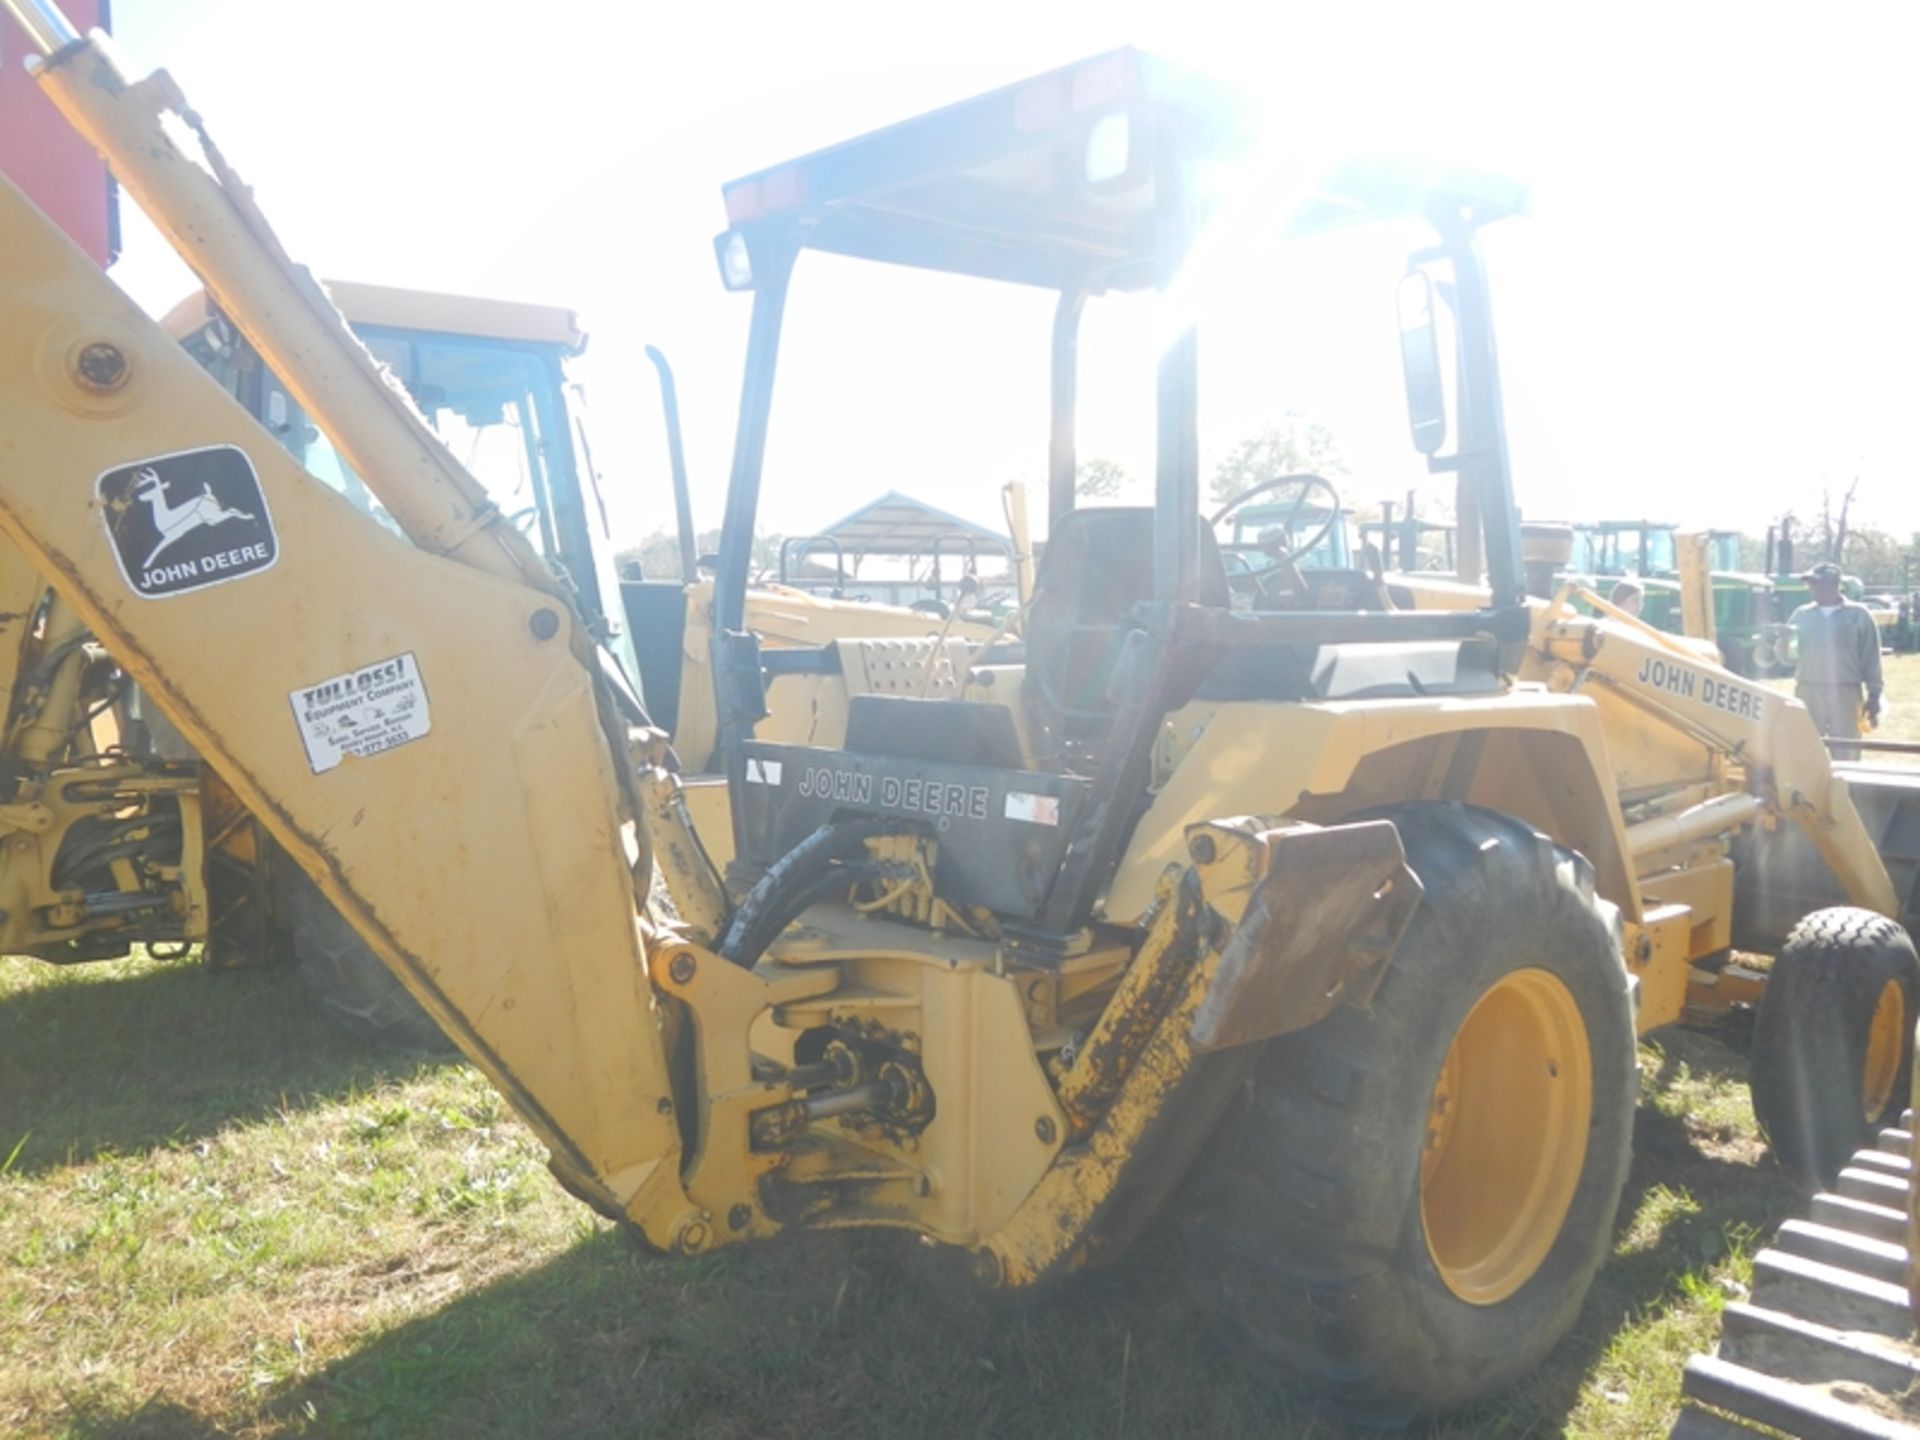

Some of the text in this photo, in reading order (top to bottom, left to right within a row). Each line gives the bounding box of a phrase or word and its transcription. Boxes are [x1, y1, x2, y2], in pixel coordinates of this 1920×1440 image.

[141, 542, 269, 588] JOHN DEERE
[1638, 657, 1763, 721] JOHN DEERE
[800, 768, 989, 818] JOHN DEERE
